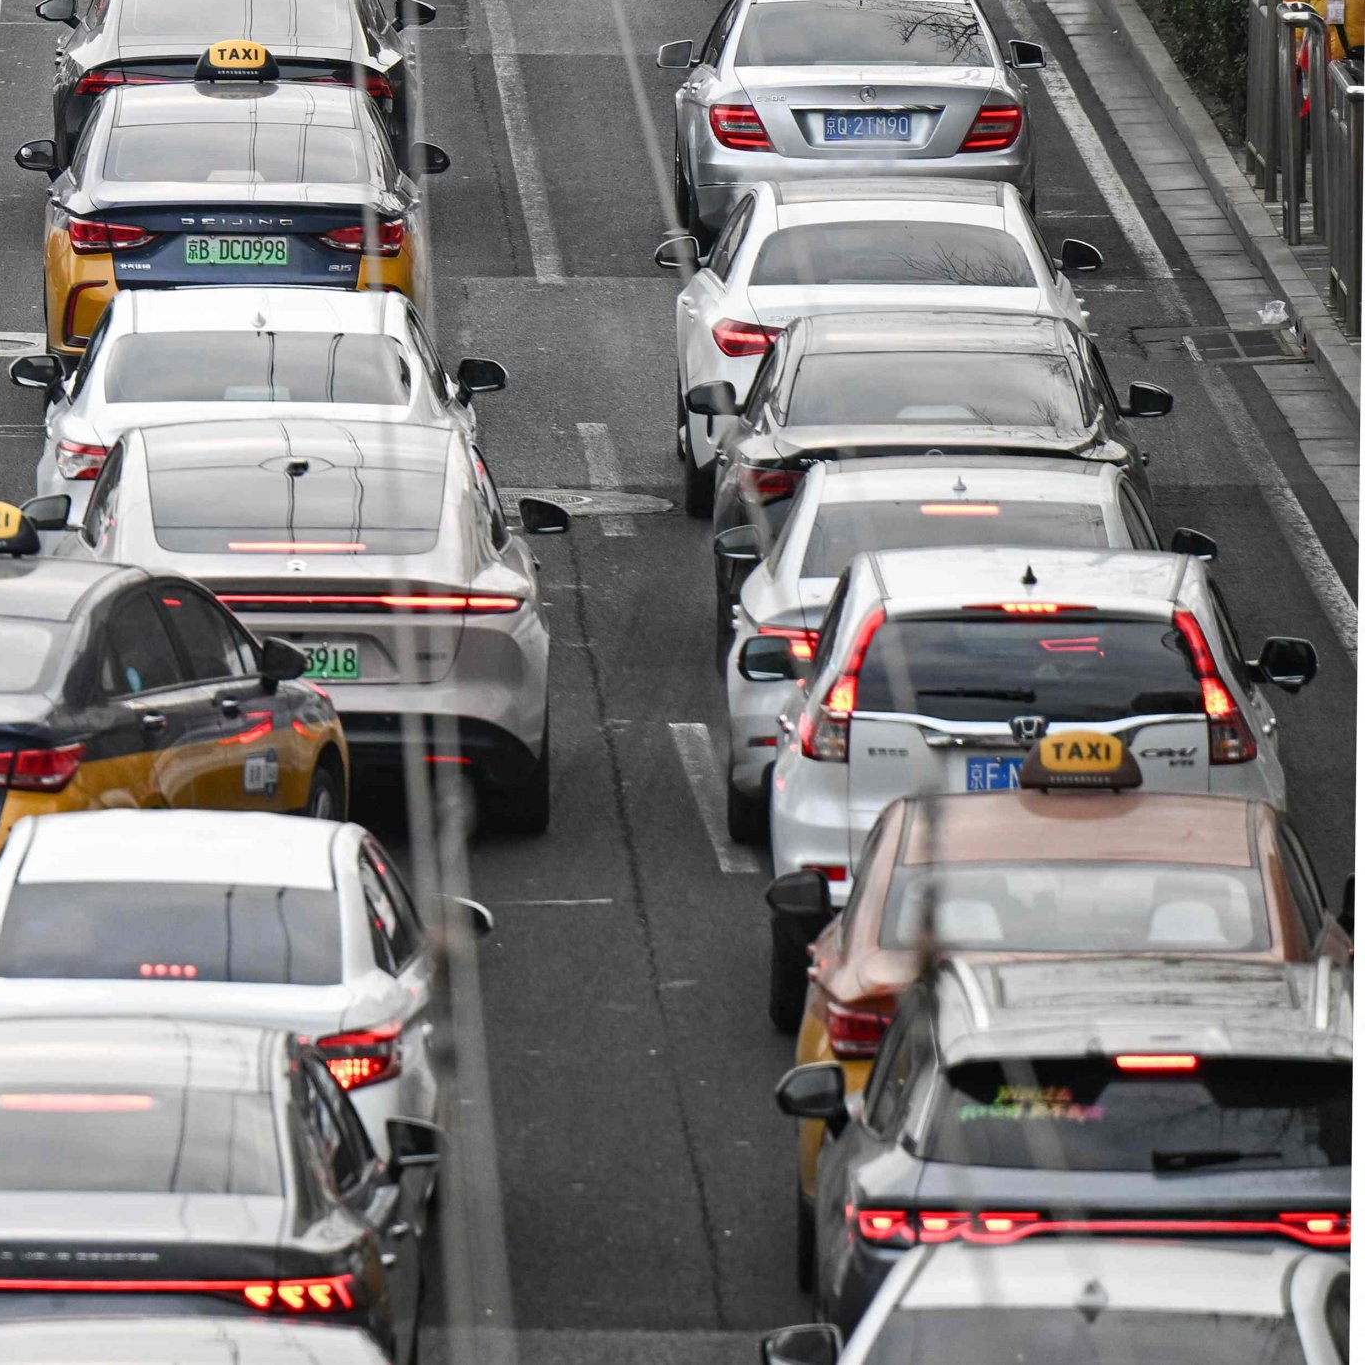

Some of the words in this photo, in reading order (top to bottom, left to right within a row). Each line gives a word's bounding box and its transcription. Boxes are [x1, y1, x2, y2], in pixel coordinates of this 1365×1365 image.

[218, 49, 258, 61] TAXI
[180, 217, 293, 226] BEIJING
[219, 240, 286, 263] DC0998
[1051, 742, 1110, 761] TAXI
